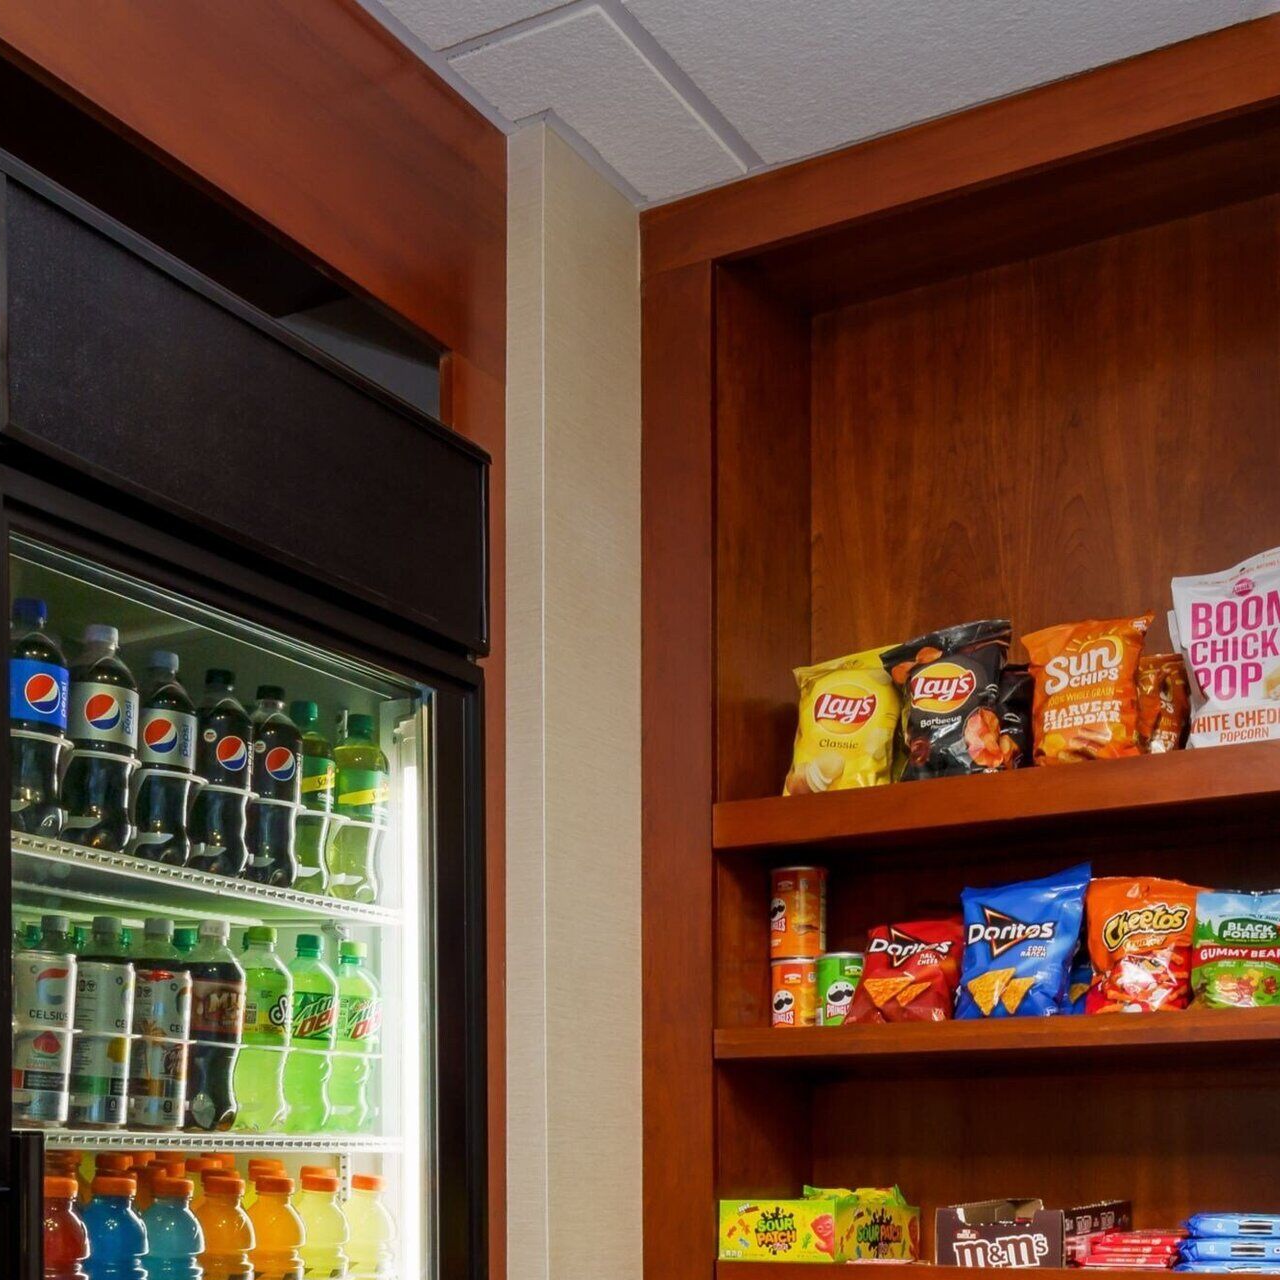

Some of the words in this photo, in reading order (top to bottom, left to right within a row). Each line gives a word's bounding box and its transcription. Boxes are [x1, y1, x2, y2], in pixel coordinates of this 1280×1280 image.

[1045, 645, 1123, 696] Sun
[1069, 668, 1119, 687] CHIPS
[913, 673, 972, 706] Lay's
[1195, 662, 1263, 701] POP
[60, 680, 68, 719] pepsi
[817, 694, 875, 724] Lay's
[124, 700, 133, 735] pepsi
[1043, 700, 1123, 721] HARVEST
[920, 715, 962, 728] Barbecue
[1043, 713, 1121, 732] CHEDDAR
[818, 738, 859, 750] Classic
[1219, 728, 1270, 743] POPCORN
[967, 922, 1054, 945] Doritos
[1102, 905, 1191, 951] Cheetos
[1223, 930, 1277, 940] FOREST
[1227, 922, 1273, 932] BLACK
[869, 938, 952, 955] Doritos
[1200, 948, 1248, 962] GUMMY
[28, 1009, 70, 1023] CELSIUS
[757, 1217, 794, 1232] SOUR
[857, 1224, 880, 1243] SOUR
[756, 1231, 797, 1245] PATCH
[953, 1235, 1049, 1268] m&m's
